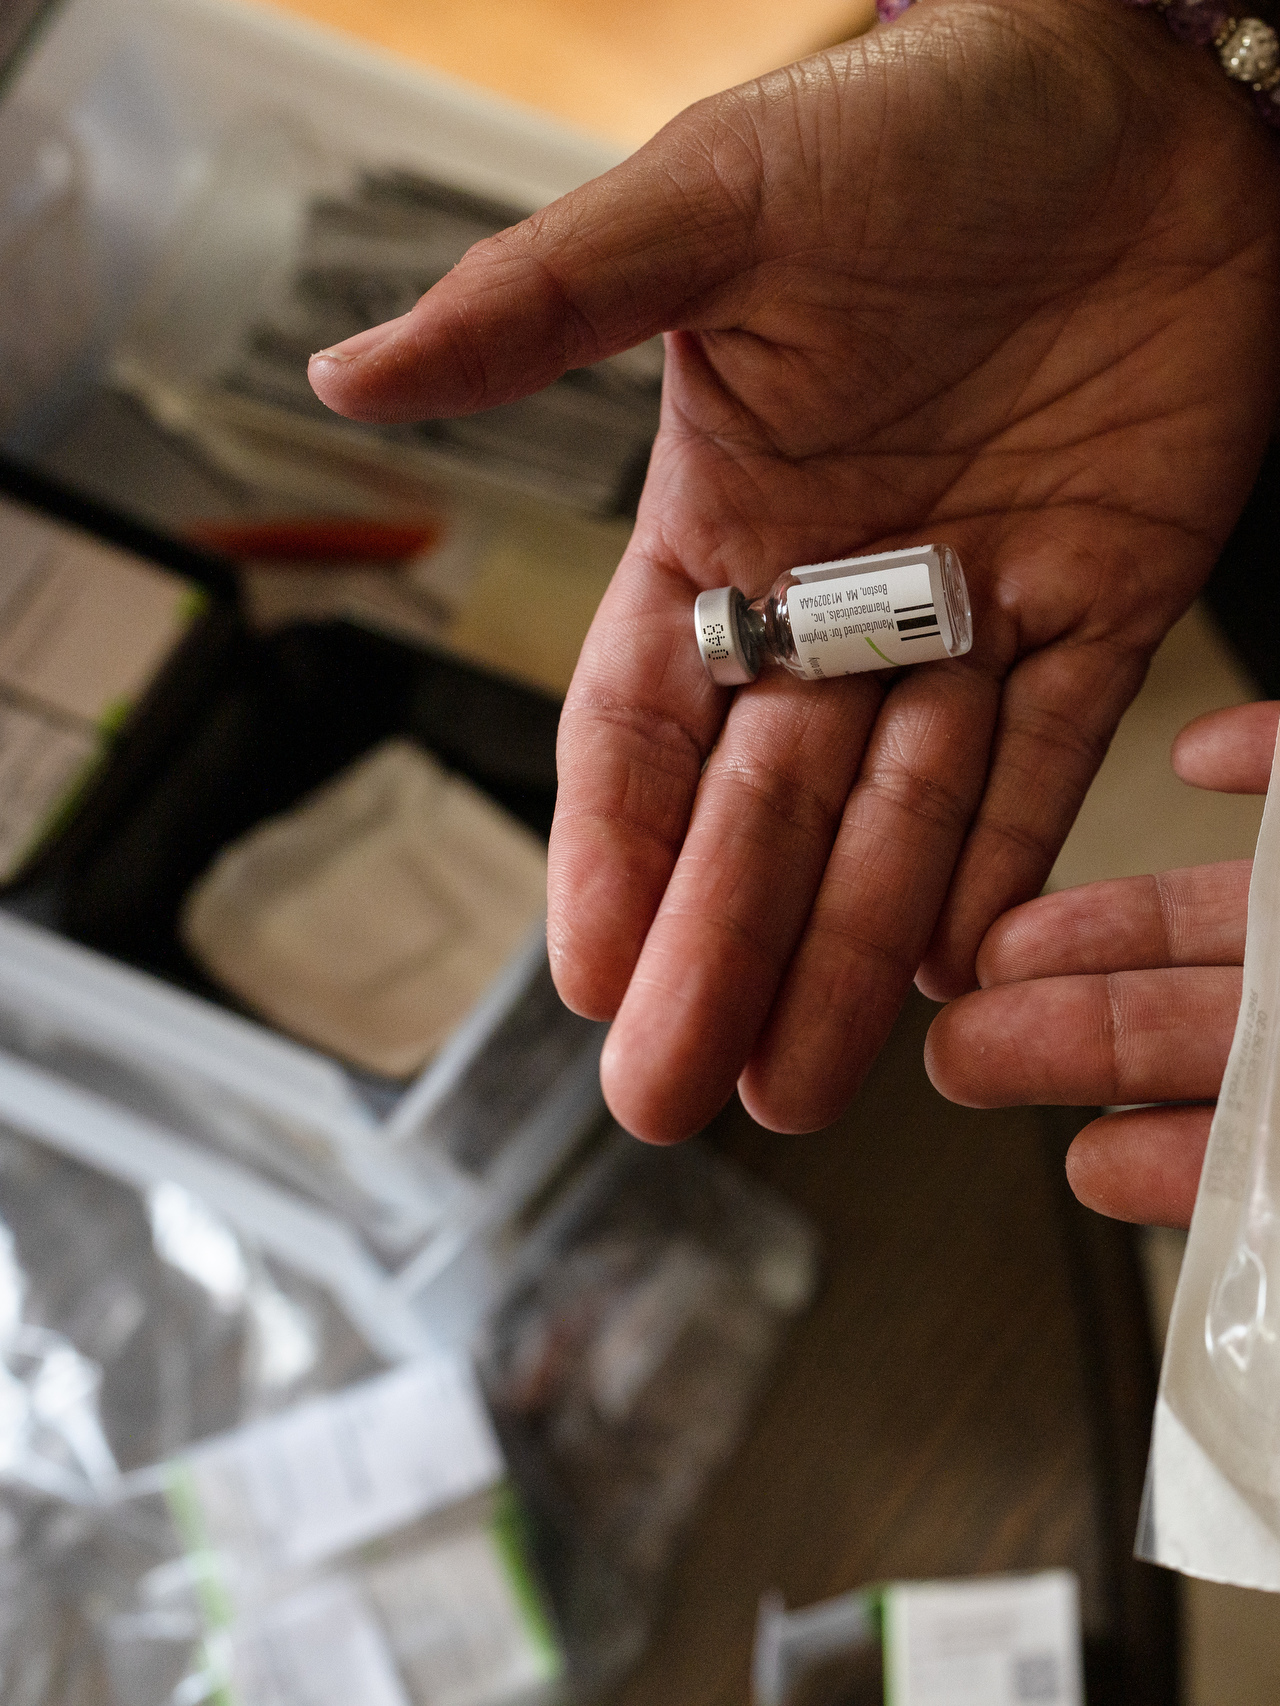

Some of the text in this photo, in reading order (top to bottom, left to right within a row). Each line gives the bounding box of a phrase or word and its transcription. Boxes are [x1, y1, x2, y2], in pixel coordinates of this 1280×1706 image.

[799, 583, 888, 610] Boston, MA M130294AA
[810, 600, 891, 624] Pharmaceuticals, Inc.
[799, 618, 895, 645] Manufactured for: Rhythm
